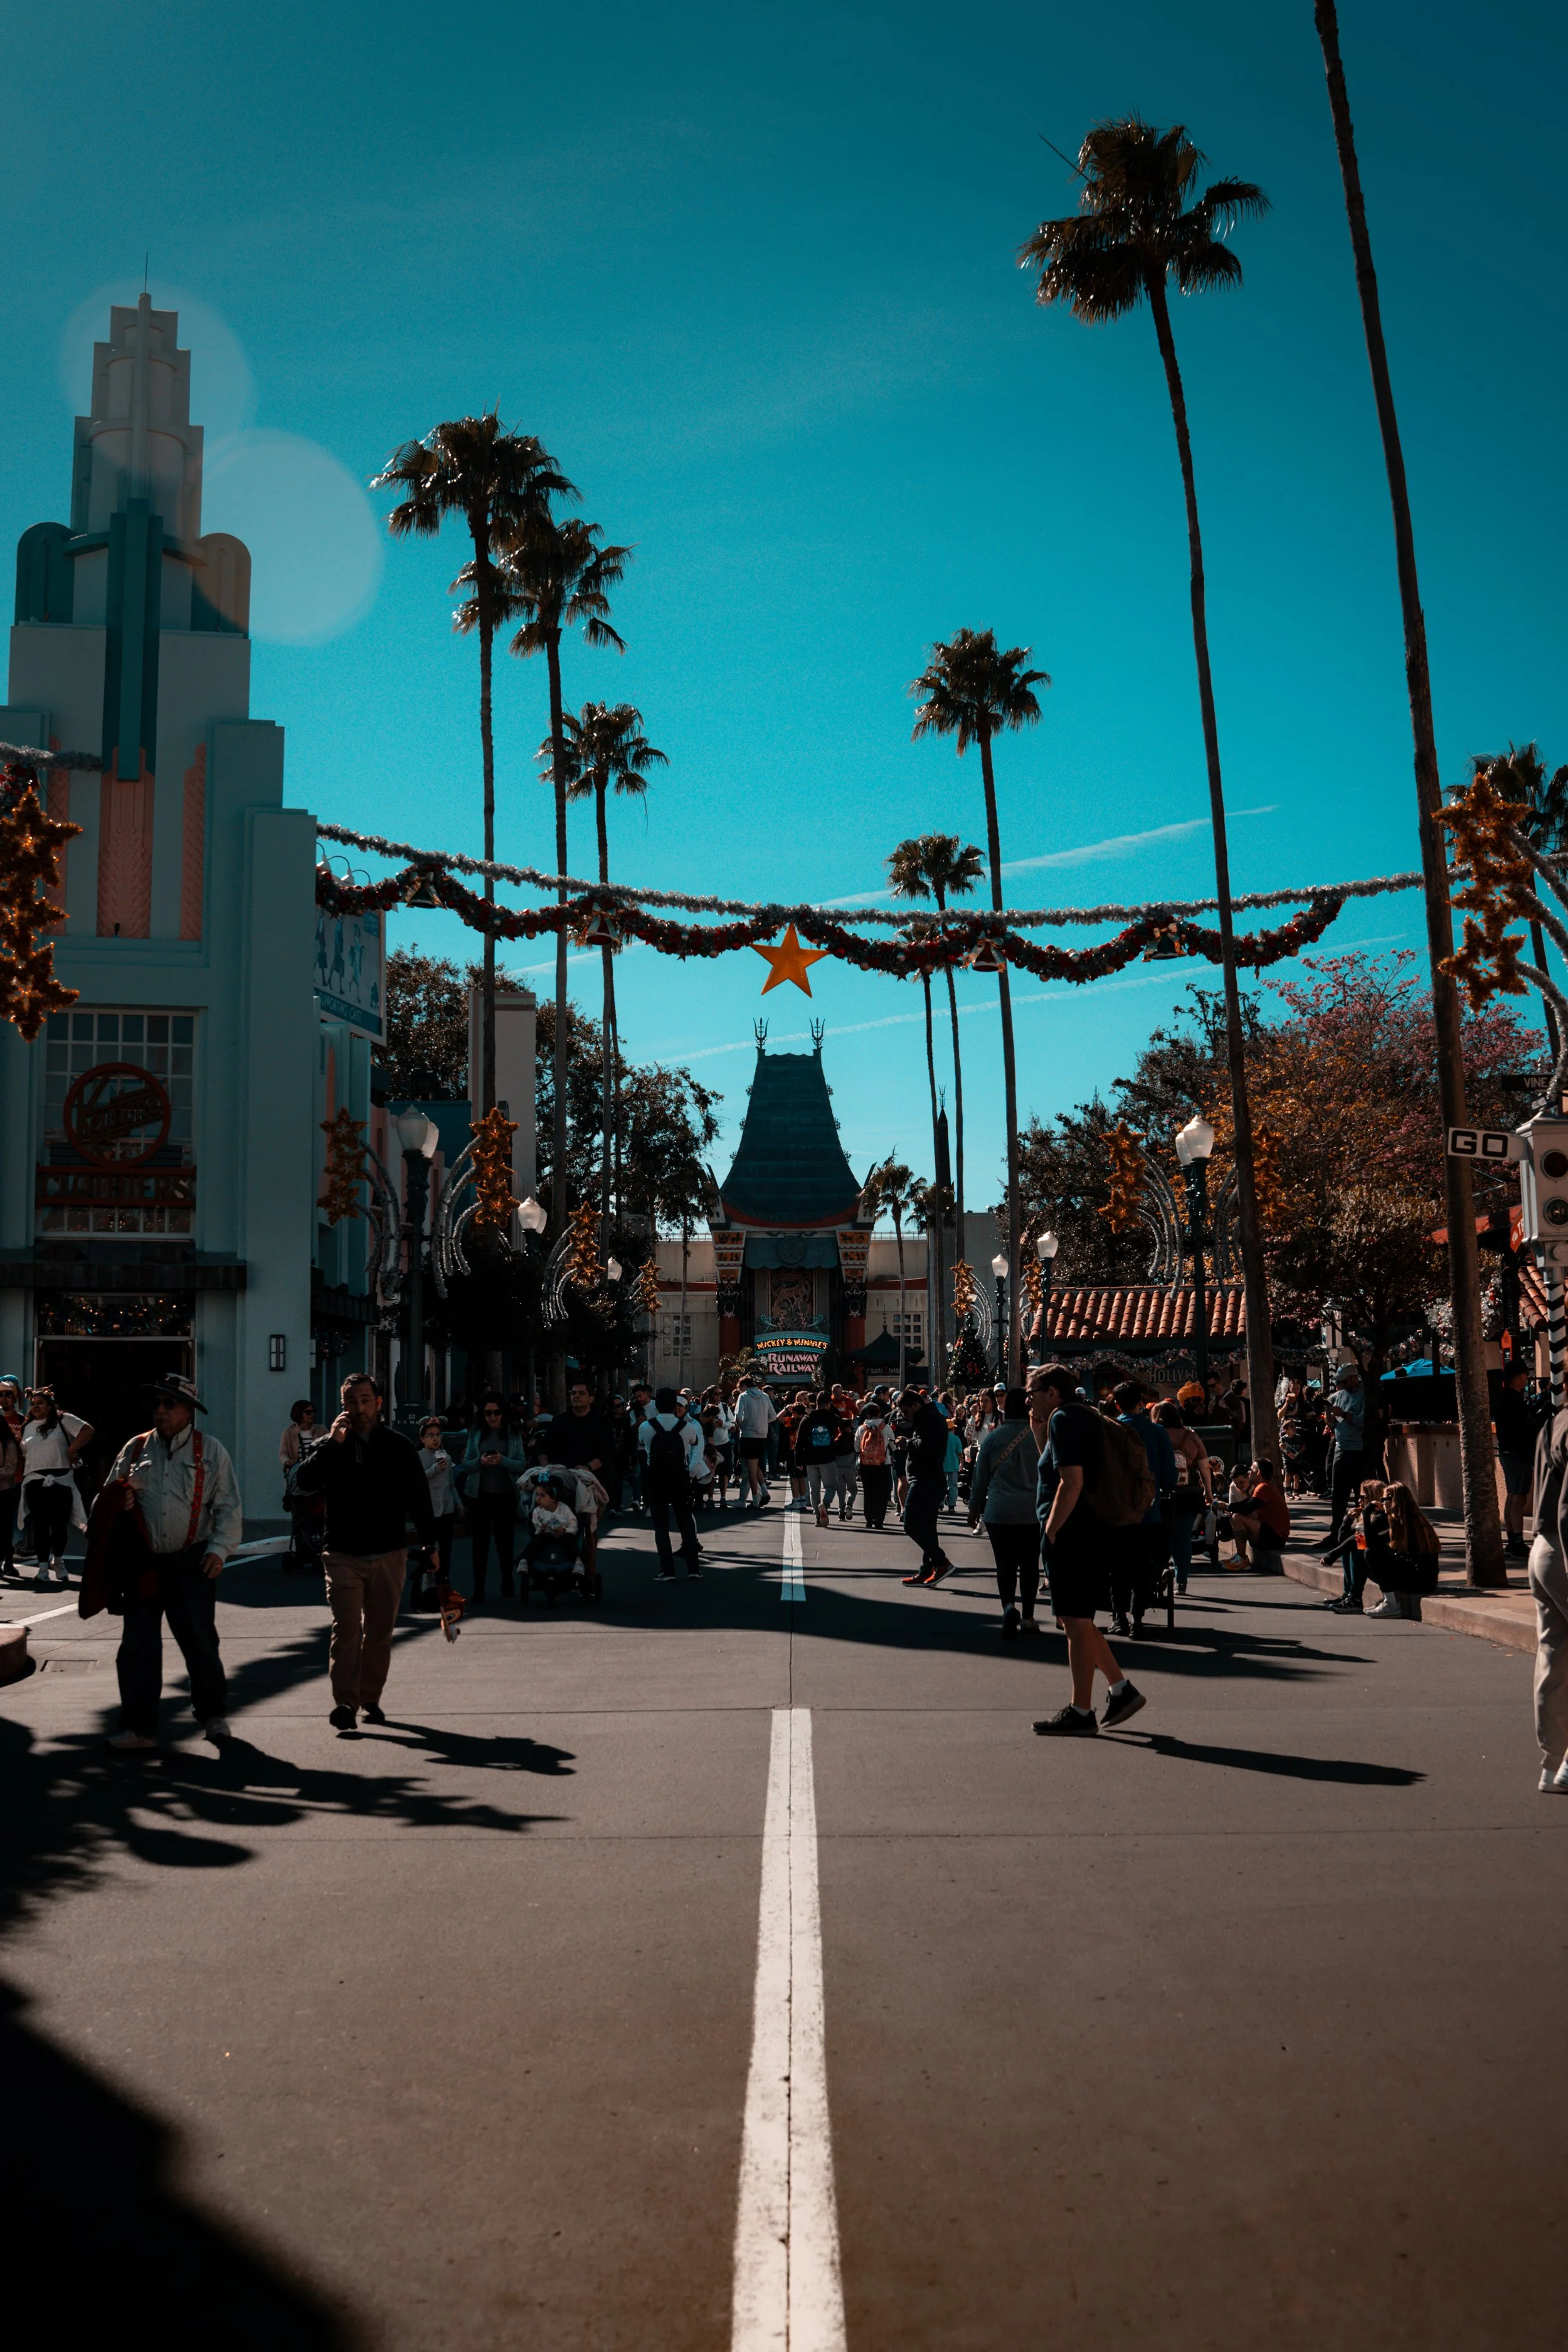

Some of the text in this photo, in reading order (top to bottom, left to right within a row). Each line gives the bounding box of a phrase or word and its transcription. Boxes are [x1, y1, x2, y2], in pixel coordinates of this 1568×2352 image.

[349, 1007, 362, 1022] CAST
[1523, 1078, 1547, 1088] VINE
[1451, 1130, 1508, 1158] GO
[43, 1174, 189, 1199] CLOTHIERS
[756, 1337, 829, 1350] MICKEY & MINNIE'S
[768, 1353, 820, 1362] RUNAWAY
[1148, 1368, 1198, 1383] HOLLYW
